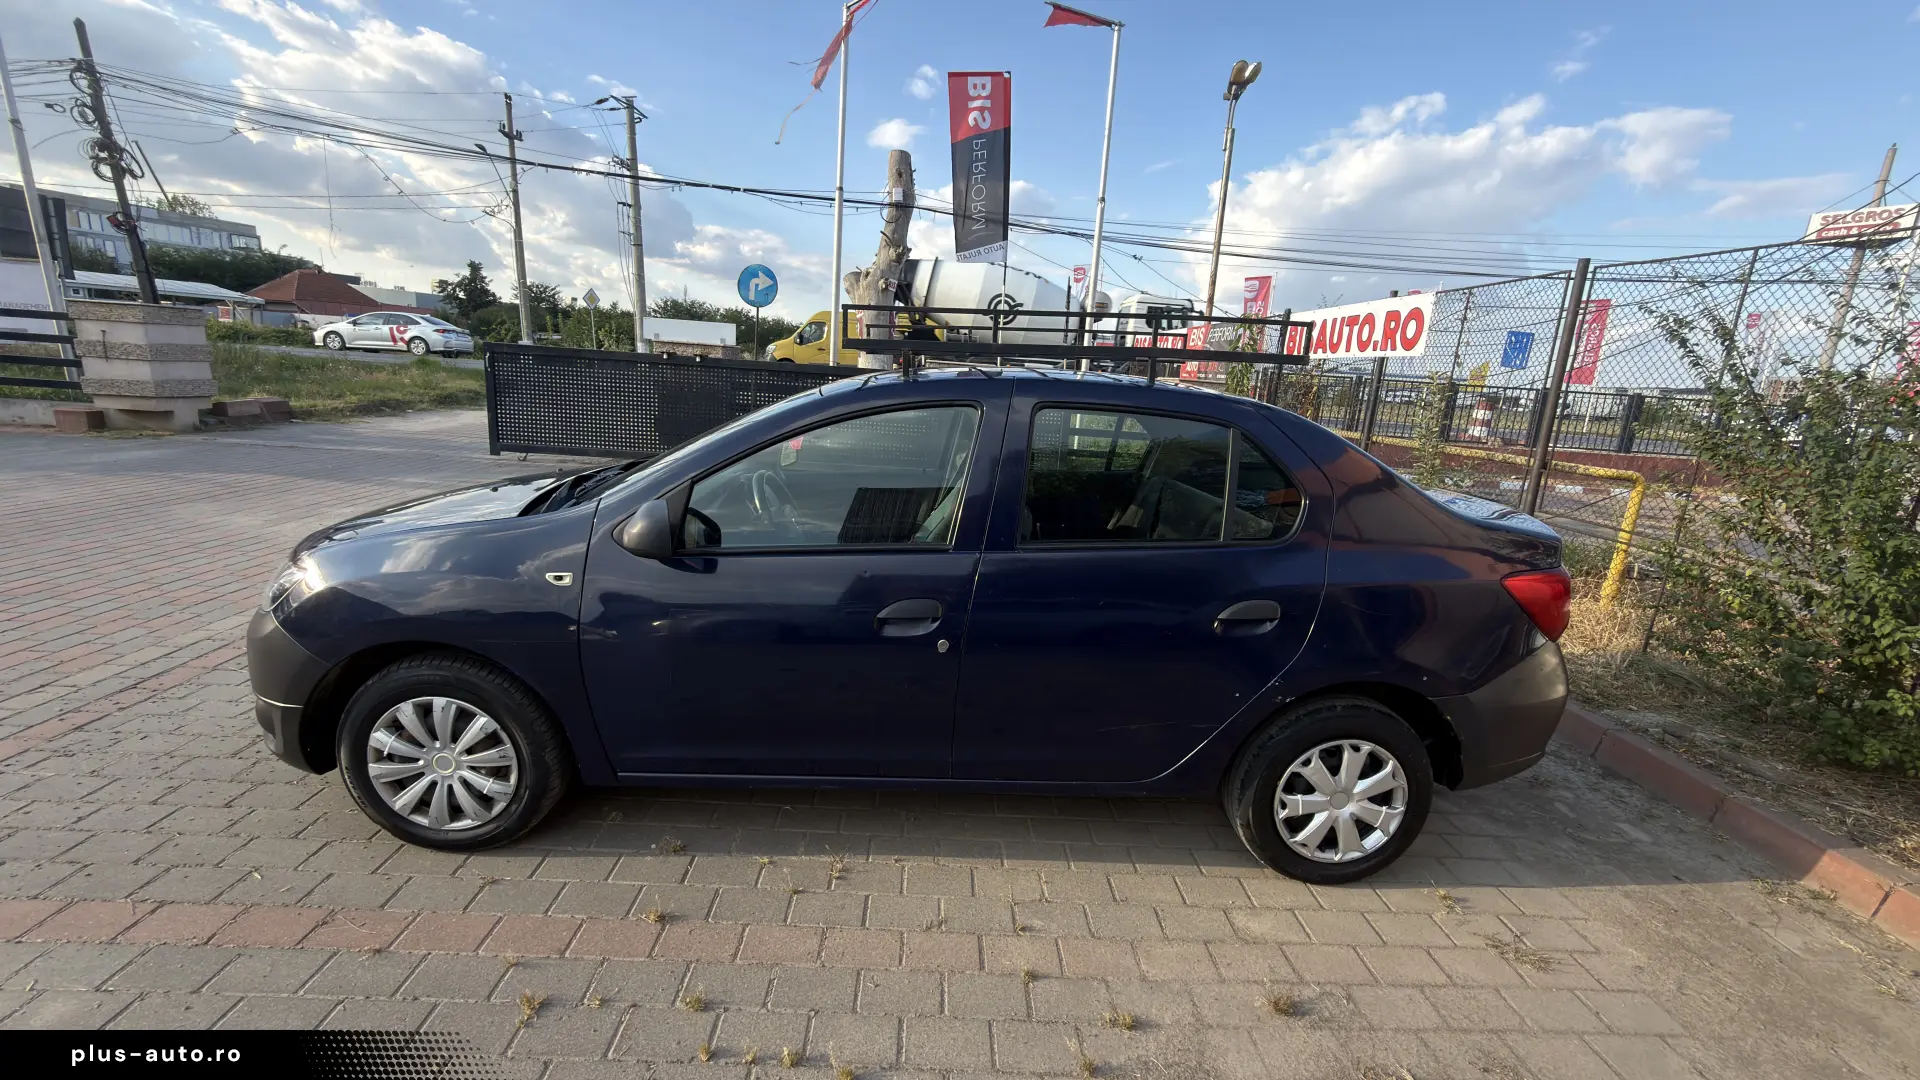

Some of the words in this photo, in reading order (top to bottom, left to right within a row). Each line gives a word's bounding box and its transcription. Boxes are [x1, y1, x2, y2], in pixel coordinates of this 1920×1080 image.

[1819, 207, 1906, 226] SELGROS
[1821, 227, 1848, 237] cash
[1850, 224, 1858, 235] &
[1189, 327, 1205, 346] BIS
